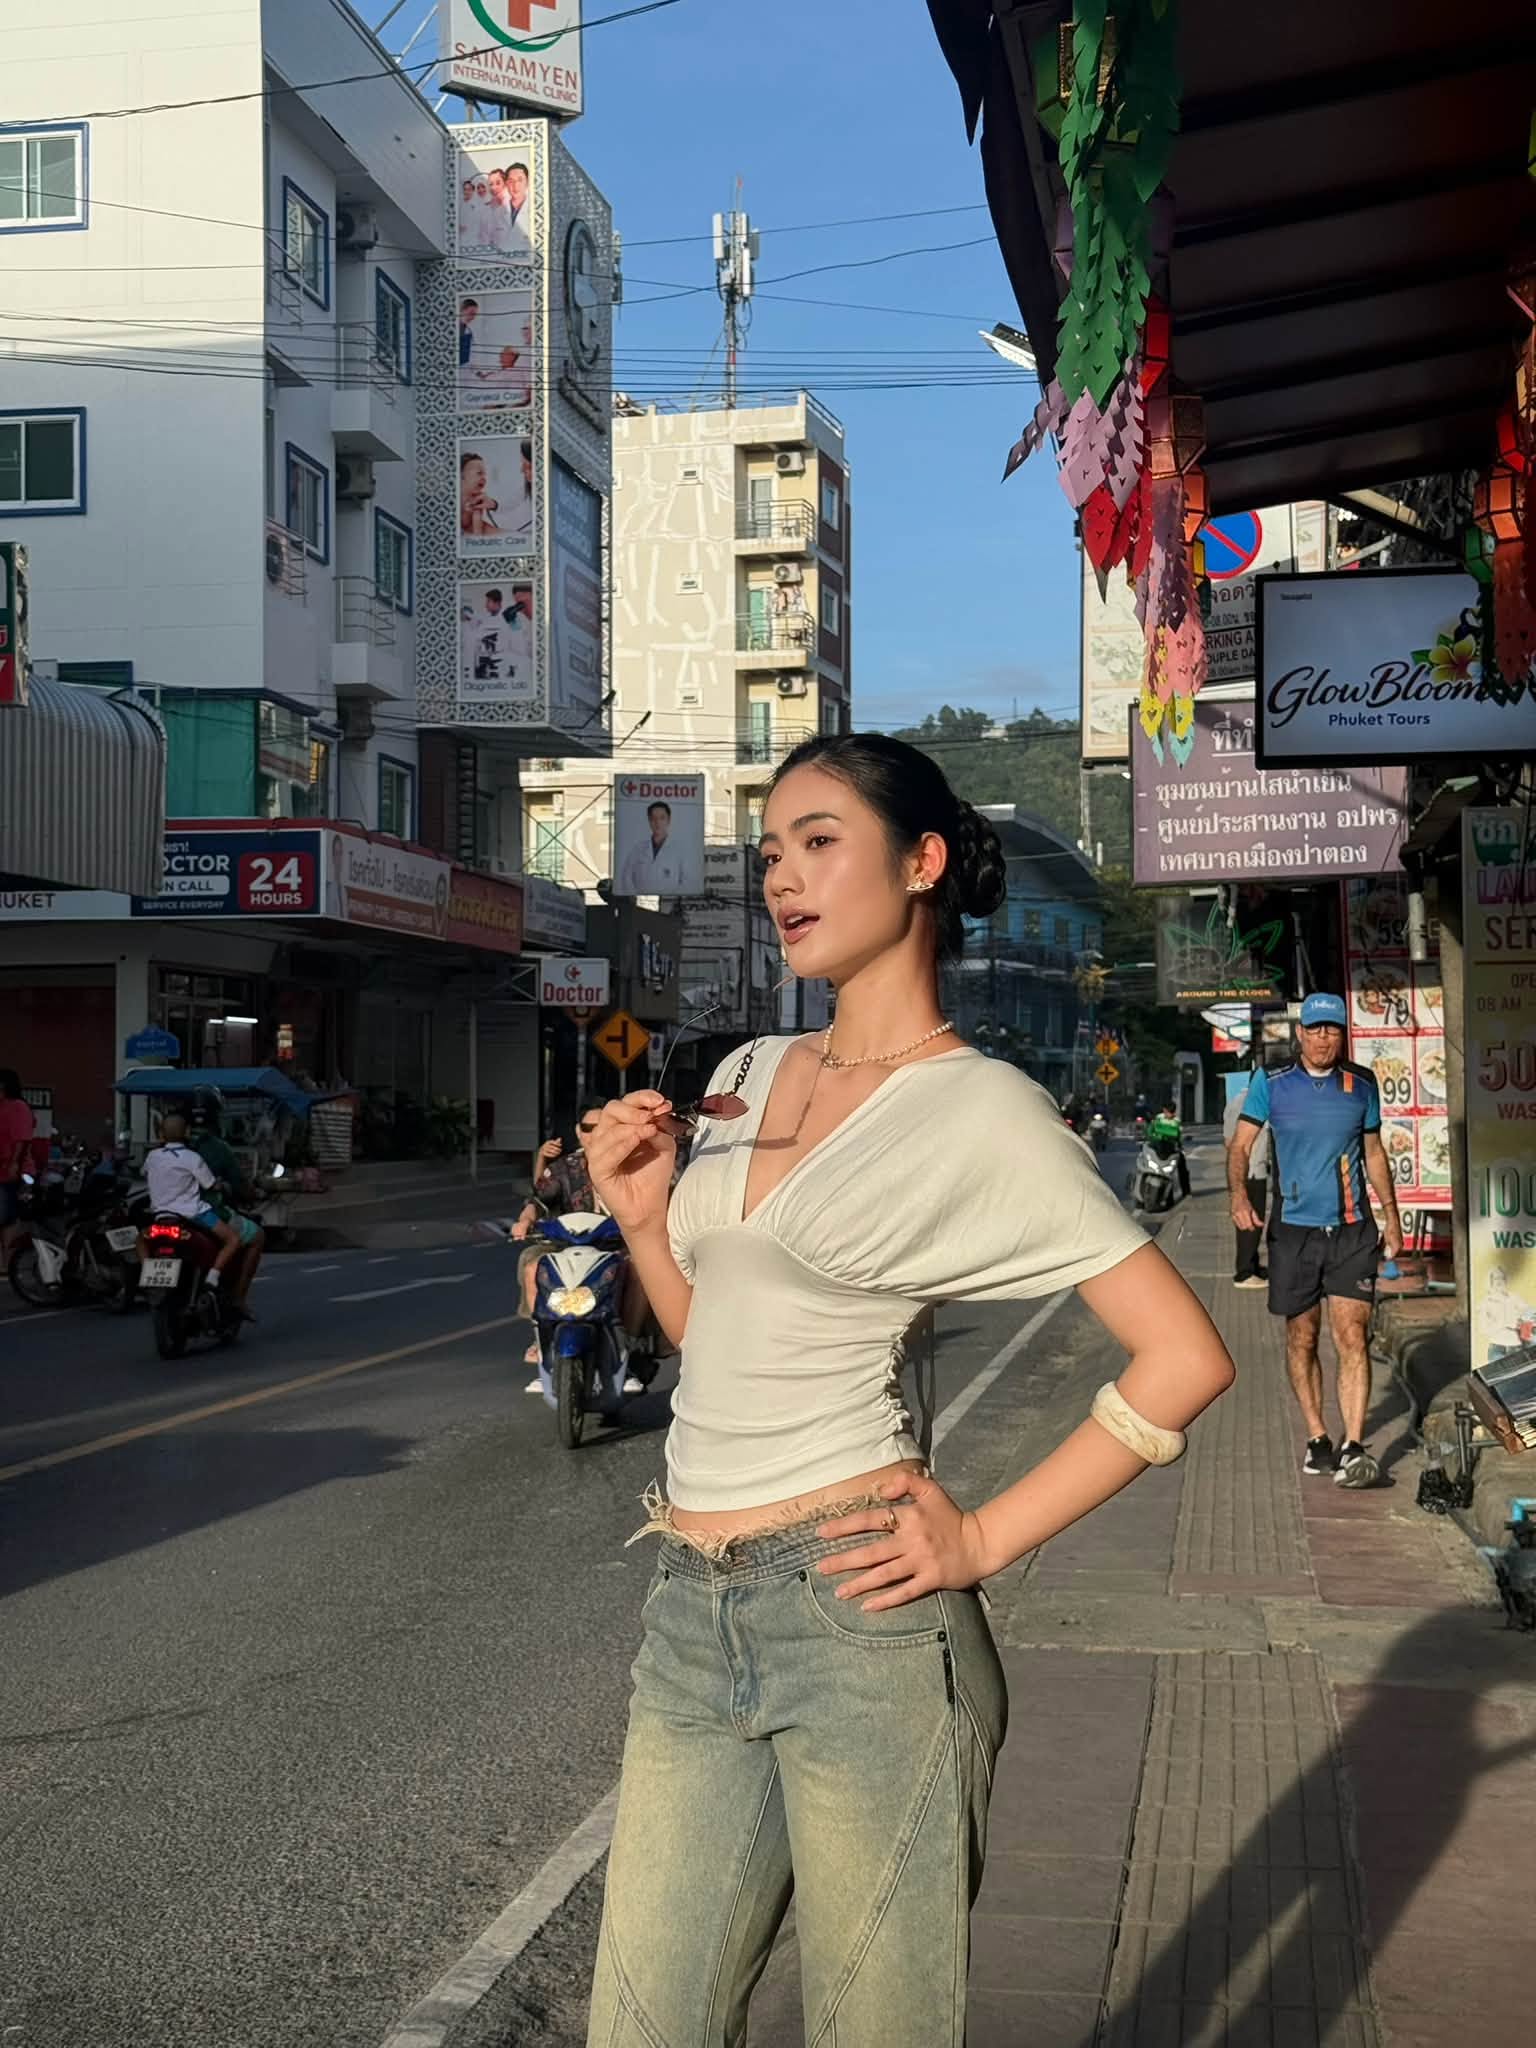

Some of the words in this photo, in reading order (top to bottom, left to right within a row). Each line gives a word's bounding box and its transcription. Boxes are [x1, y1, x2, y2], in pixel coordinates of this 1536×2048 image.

[455, 42, 577, 90] SAINAMYEN
[453, 64, 539, 95] INTERNATIONAL
[543, 84, 577, 104] CLINIC
[1206, 631, 1242, 649] RKING
[1329, 713, 1384, 726] Phuket
[1388, 713, 1431, 726] Tours
[639, 783, 698, 798] Doctor
[1158, 804, 1327, 843] ศูนย์ประสานงาน
[1160, 833, 1368, 872] เทศบาลเมืองป่าตอง
[249, 857, 303, 891] 24
[179, 880, 214, 892] CALL
[0, 893, 56, 909] UKET
[179, 900, 225, 911] EVERYDAY
[250, 892, 303, 905] HOURS
[543, 982, 604, 1002] Doctor
[1176, 990, 1217, 999] AROUND
[1219, 989, 1237, 998] THE
[1383, 1076, 1412, 1105] 99
